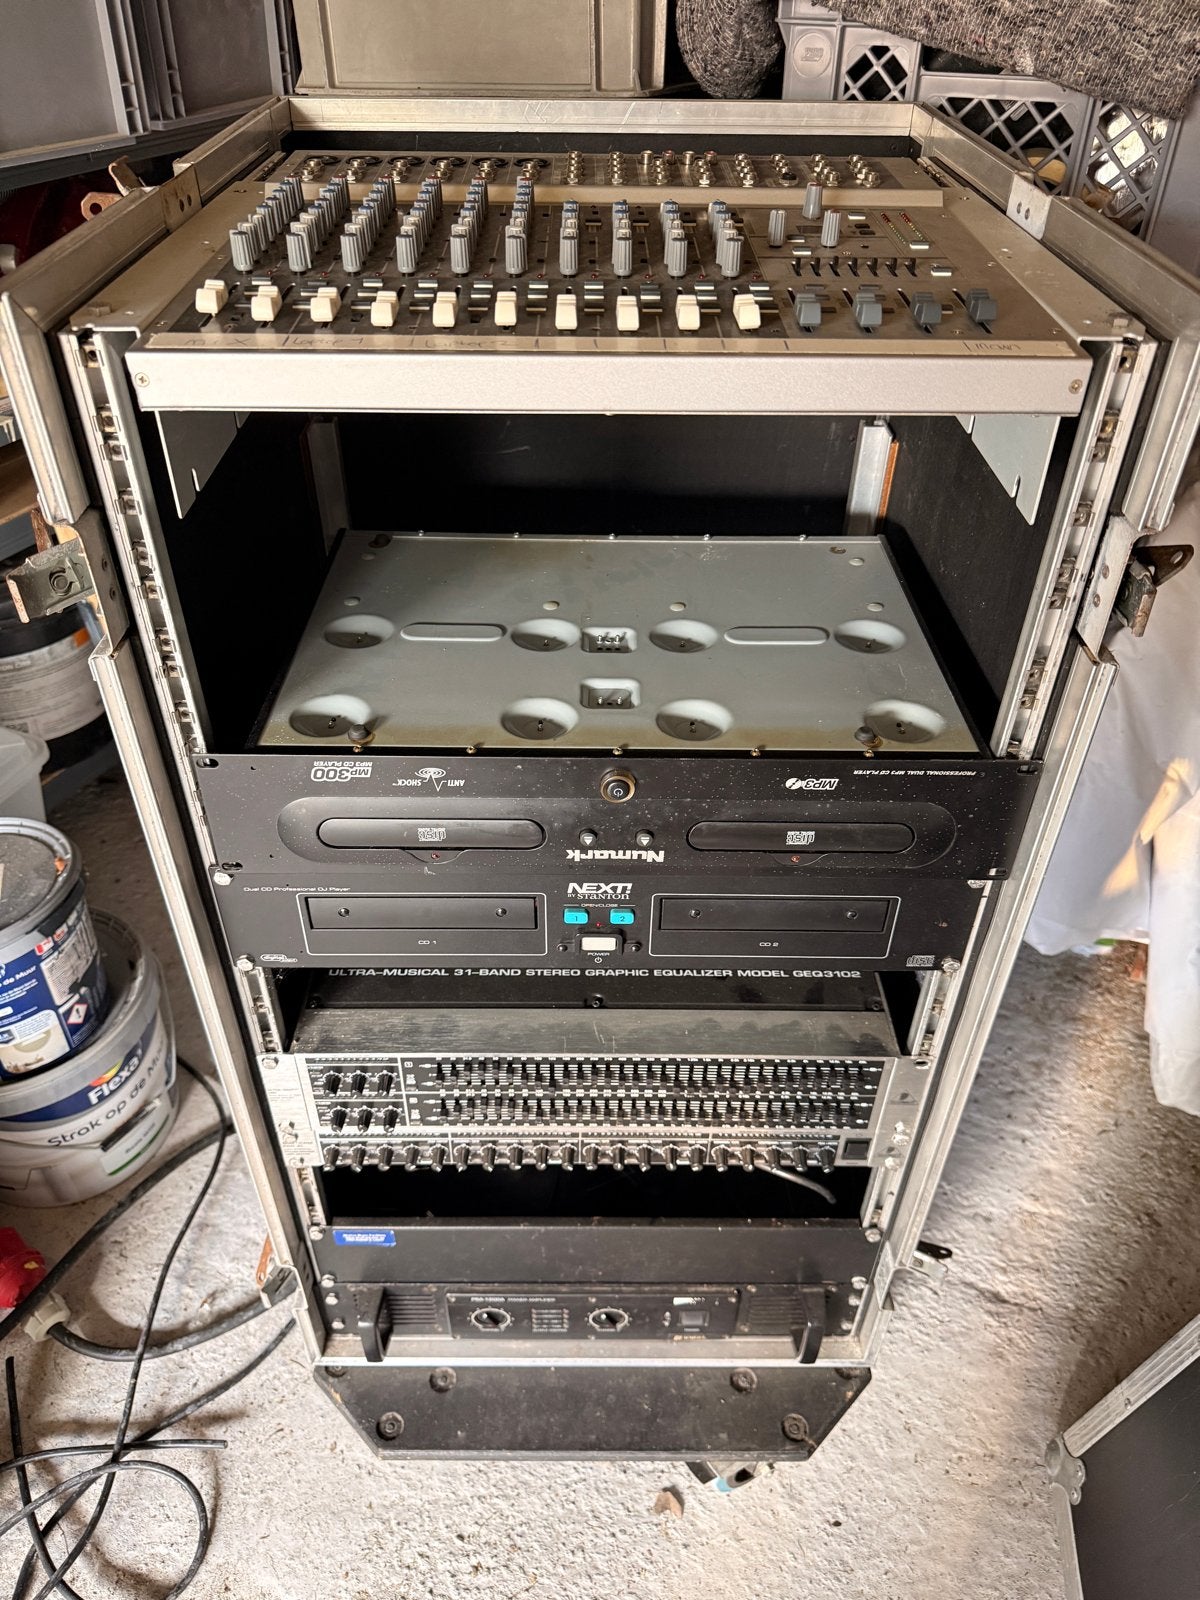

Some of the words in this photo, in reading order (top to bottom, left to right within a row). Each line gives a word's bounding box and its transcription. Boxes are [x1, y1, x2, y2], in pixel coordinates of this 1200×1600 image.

[311, 766, 372, 782] MP300
[447, 779, 465, 787] ANTI
[803, 778, 839, 790] MP3
[565, 849, 665, 863] Numark
[567, 883, 633, 894] NEXT!
[525, 969, 581, 977] STEREO
[584, 969, 650, 977] GRAPHIC
[653, 969, 734, 977] EQUALIZER
[737, 970, 790, 978] MODEL
[792, 970, 862, 978] GEQ3102
[87, 1056, 140, 1106] Flexa
[47, 1119, 103, 1147] Strak
[105, 1100, 127, 1120] op
[130, 1077, 146, 1099] de
